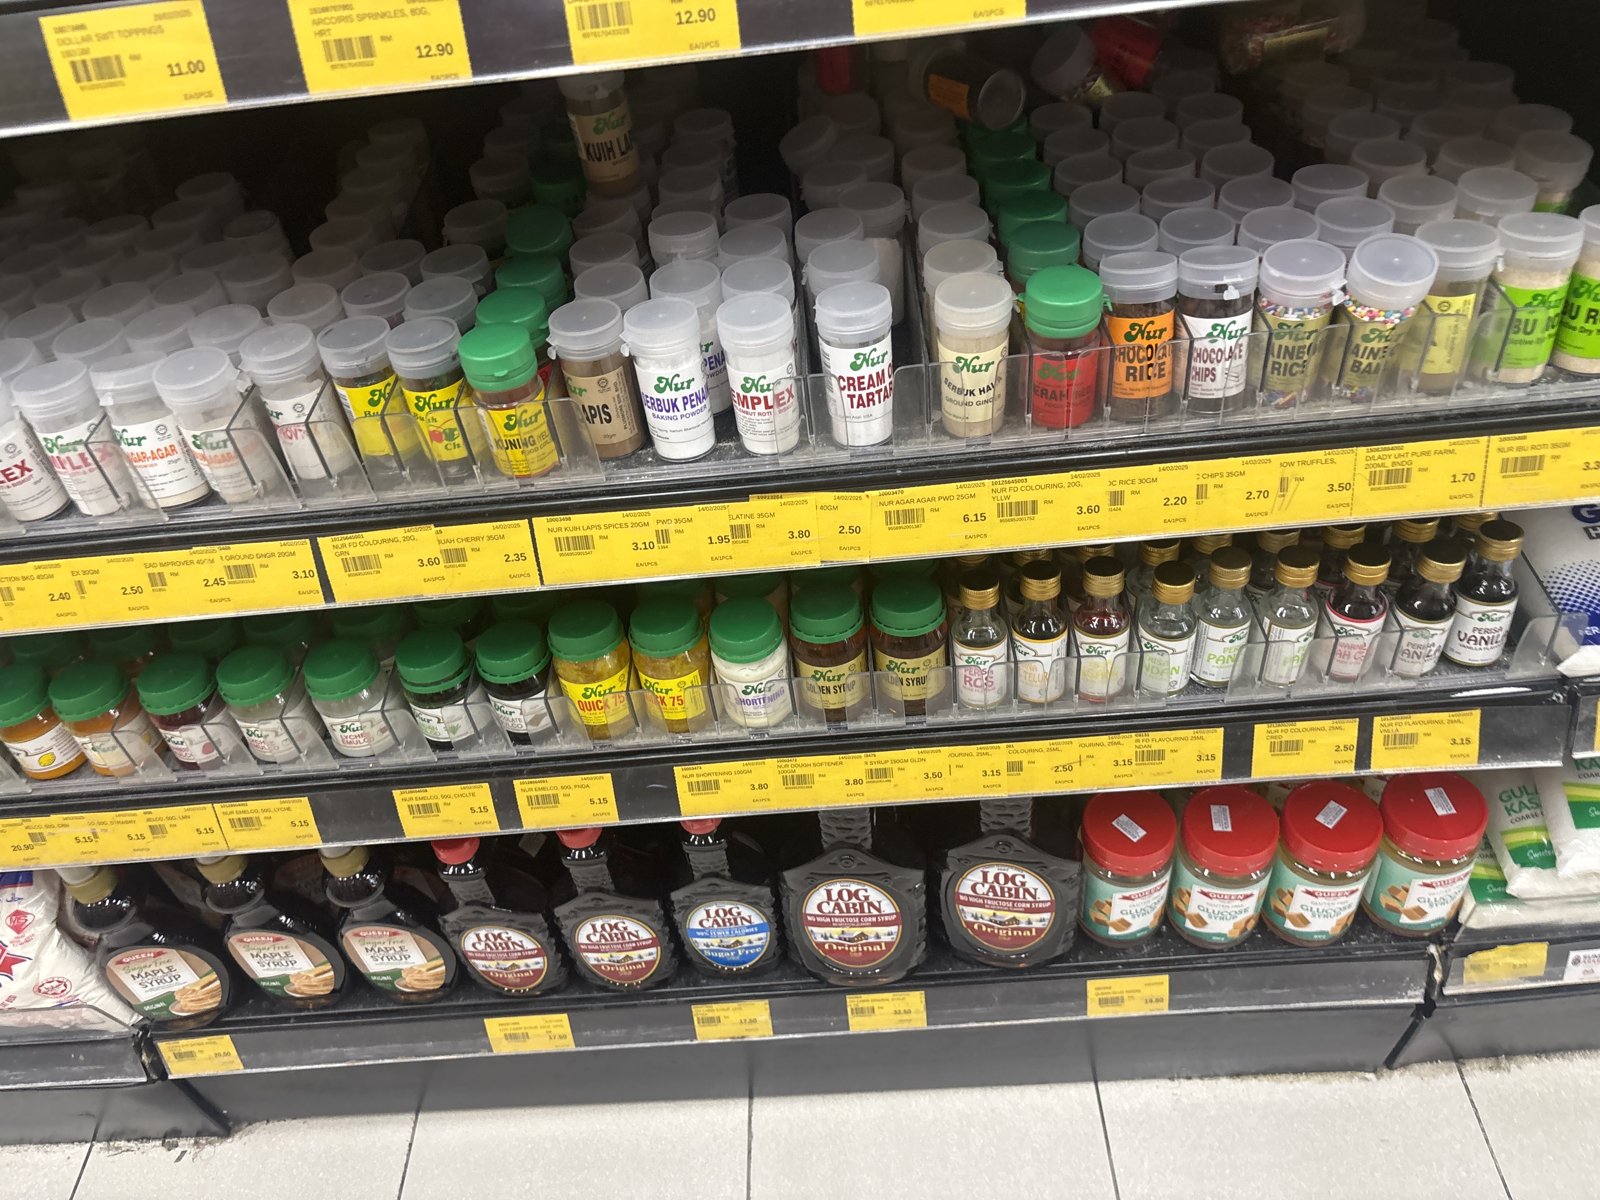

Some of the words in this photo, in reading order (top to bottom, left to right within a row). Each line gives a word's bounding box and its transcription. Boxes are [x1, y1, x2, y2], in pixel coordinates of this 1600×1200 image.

[675, 8, 716, 25] 12.90
[416, 43, 454, 58] 12.90
[167, 60, 205, 77] 11.00
[583, 139, 617, 162] KUIH
[1124, 320, 1167, 342] Nur
[1206, 321, 1248, 343] Nur
[850, 348, 888, 371] Nur
[952, 355, 994, 374] Nur
[1125, 362, 1166, 383] RICE
[653, 374, 695, 394] Nur
[838, 372, 886, 391] CREAM
[944, 378, 977, 397] SERBUK
[415, 395, 454, 412] Nur
[651, 412, 679, 422] BAKING
[680, 404, 708, 420] POWDER
[504, 408, 542, 431] Nur
[496, 434, 536, 450] KUNING
[1410, 450, 1431, 458] PURE
[1201, 472, 1224, 480] CHIPS
[1225, 470, 1246, 479] 35GM
[1450, 472, 1476, 484] 1.70
[991, 487, 1007, 495] NUR
[1008, 486, 1018, 494] FD
[1019, 482, 1066, 492] COLOURING,
[1067, 481, 1083, 489] 20G,
[1326, 482, 1352, 493] 3.50
[879, 500, 895, 508] NUR
[896, 498, 916, 507] AGAR
[917, 496, 937, 505] AGAR
[938, 495, 955, 503] PWD
[956, 493, 977, 501] 25GM
[991, 494, 1011, 502] YLLW
[1245, 489, 1270, 501] 2.70
[1163, 496, 1188, 507] 2.20
[1076, 504, 1101, 515] 3.60
[673, 517, 693, 525] 35GM
[962, 512, 987, 524] 6.15
[548, 526, 563, 534] NUR
[564, 525, 581, 533] KUIH
[603, 522, 629, 530] SPICES
[630, 521, 650, 529] 20GM
[838, 525, 862, 536] 2.50
[456, 535, 485, 544] CHERRY
[486, 534, 506, 542] 35GM
[788, 529, 811, 540] 3.80
[332, 543, 348, 551] NUR
[349, 542, 358, 550] FD
[358, 537, 401, 548] COLOURING,
[402, 535, 418, 543] 20G,
[632, 541, 655, 551] 3.10
[708, 535, 731, 546] 1.95
[225, 553, 255, 561] GROUND
[334, 550, 350, 558] GRN
[504, 552, 527, 563] 2.35
[417, 557, 441, 568] 3.60
[292, 569, 315, 580] 3.10
[203, 577, 226, 588] 2.45
[49, 591, 71, 602] 2.40
[120, 586, 144, 596] 2.50
[1472, 626, 1503, 635] PERISA
[1086, 645, 1111, 656] Nur
[886, 659, 920, 674] Nur
[965, 657, 989, 666] Nur
[811, 670, 845, 683] Nur
[963, 675, 994, 688] ROS
[581, 684, 616, 699] Nur
[741, 682, 774, 696] Nur
[577, 697, 610, 712] QUICK
[612, 694, 625, 707] 75
[1450, 737, 1472, 746] 3.15
[1334, 744, 1355, 752] 2.50
[1112, 758, 1133, 768] 3.15
[1196, 753, 1216, 762] 3.15
[791, 762, 811, 770] DOUGH
[812, 760, 844, 768] SOFTENER
[1053, 764, 1073, 773] 2.50
[696, 770, 733, 778] SHORTENING
[923, 771, 943, 780] 3.50
[981, 769, 1001, 777] 3.15
[750, 782, 769, 791] 3.80
[844, 778, 864, 787] 3.80
[589, 797, 609, 806] 5.15
[469, 805, 489, 814] 5.15
[290, 819, 310, 828] 5.15
[196, 827, 215, 835] 5.15
[74, 836, 94, 844] 5.15
[127, 833, 146, 841] 5.15
[11, 843, 35, 852] 20.90
[981, 870, 1027, 887] LOG
[826, 888, 870, 902] LOG
[970, 882, 1039, 900] CABIN
[1131, 886, 1161, 899] QUEEN
[969, 896, 984, 904] HIGH
[984, 898, 1013, 907] FRUCTOSE
[704, 906, 742, 919] LOG
[816, 901, 884, 915] CABIN
[1197, 905, 1250, 916] GLUCOSE
[1300, 903, 1353, 914] GLUCOSE
[698, 915, 754, 928] CABIN
[1207, 913, 1238, 921] SYRUP
[590, 921, 629, 933] LOG
[973, 923, 1037, 937] Original
[475, 931, 512, 943] LOG
[586, 930, 641, 943] CABIN
[365, 945, 409, 954] MAPLE
[472, 941, 526, 951] CABIN
[824, 942, 887, 953] Original
[122, 951, 154, 964] QUEEN
[251, 951, 294, 960] MAPLE
[370, 954, 411, 962] SYRUP
[703, 948, 737, 959] Sugar
[738, 947, 762, 956] Free
[257, 959, 297, 968] SYRUP
[602, 963, 646, 973] Original
[131, 965, 178, 982] MAPLE
[490, 970, 533, 979] Original
[138, 974, 181, 990] SYRUP
